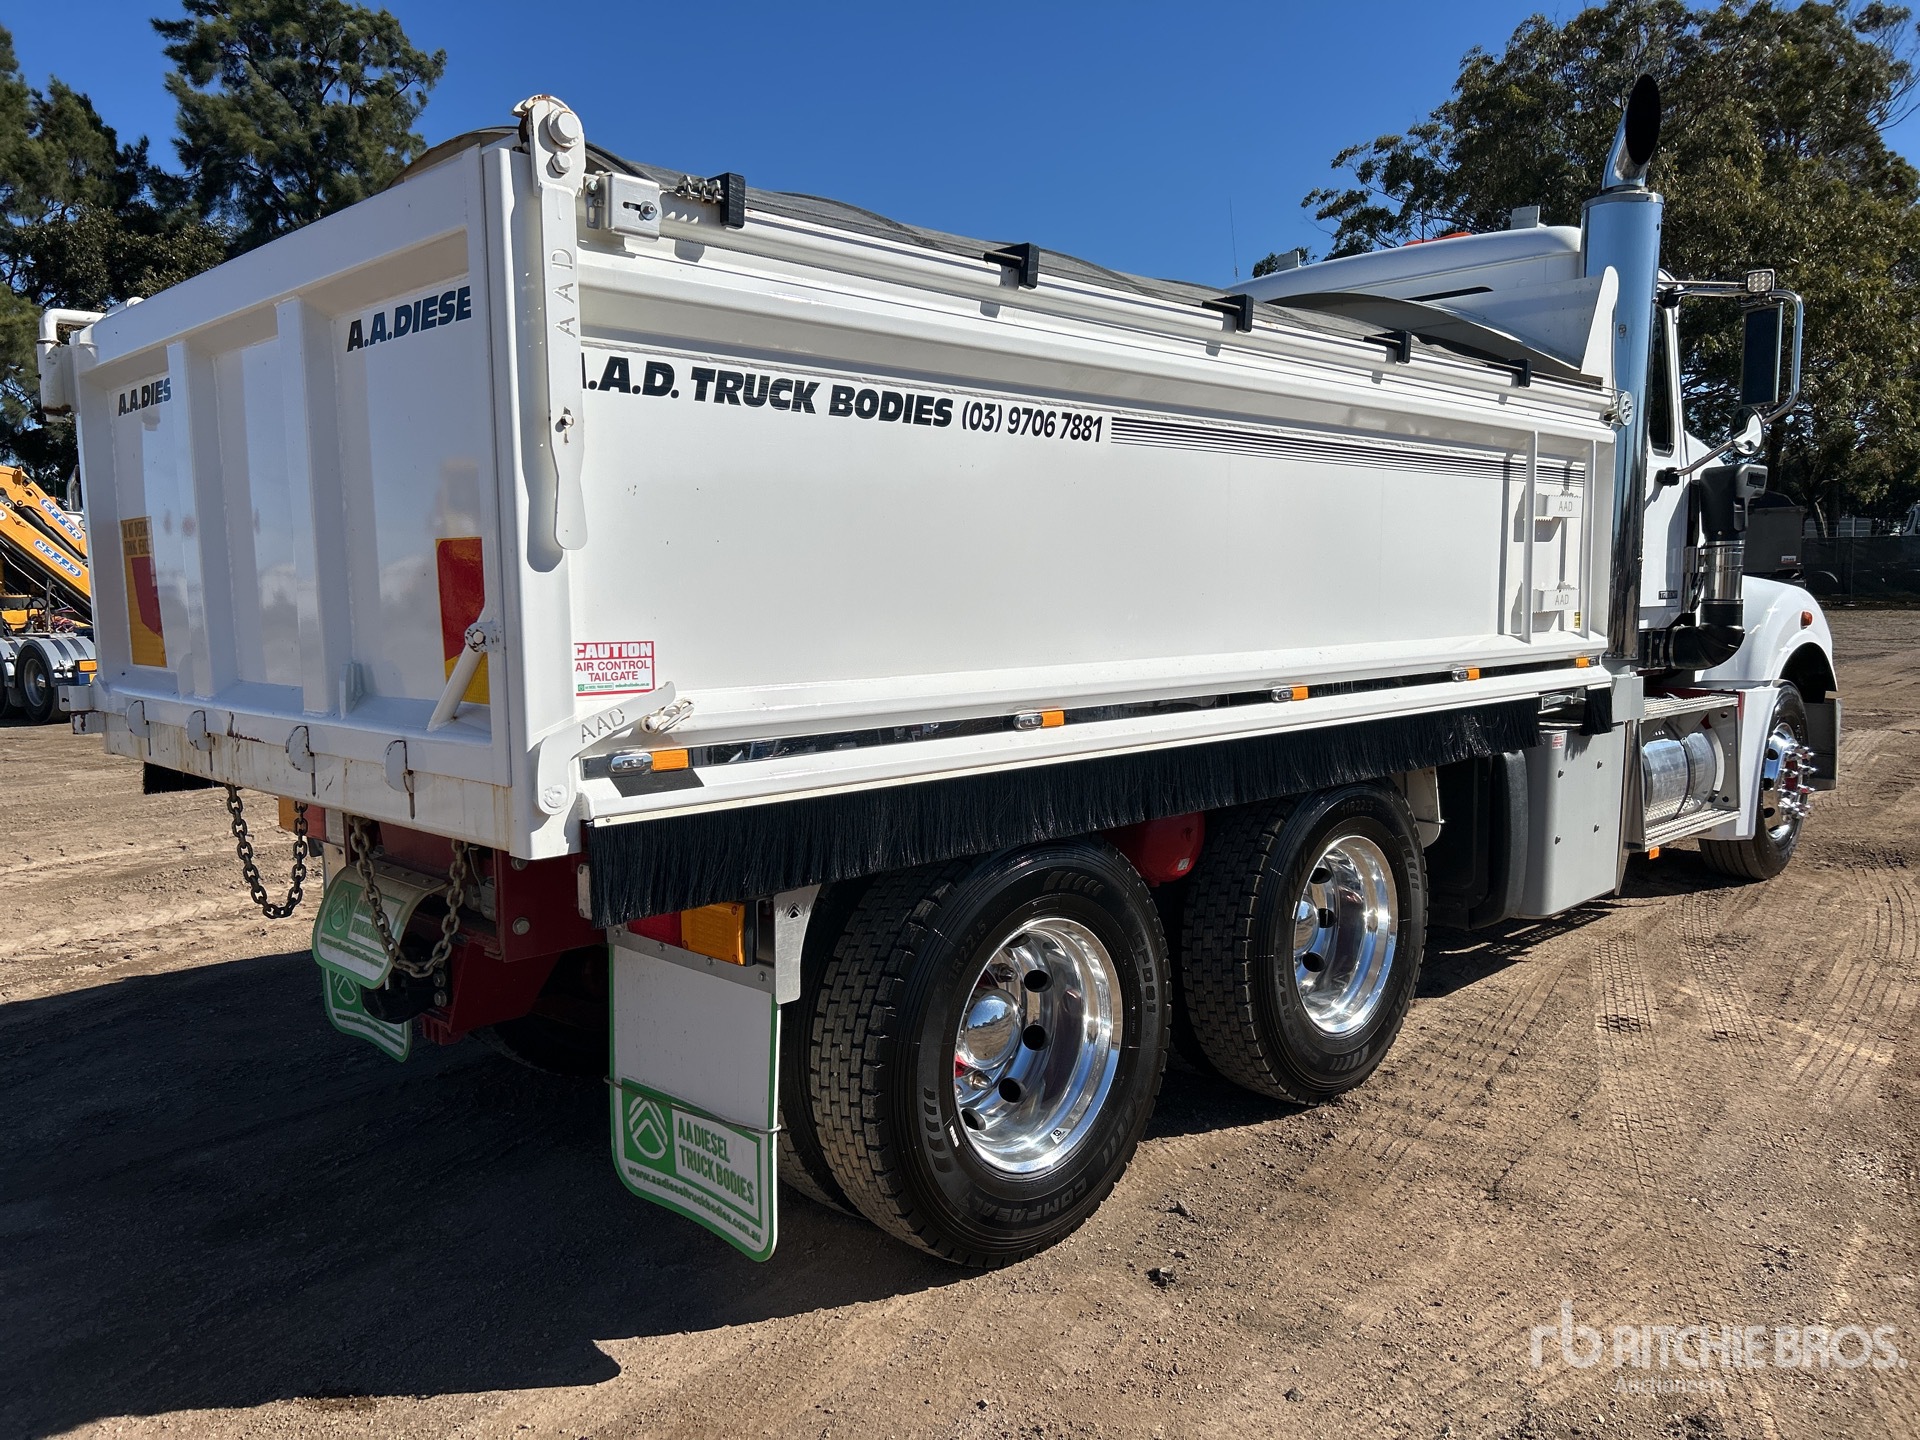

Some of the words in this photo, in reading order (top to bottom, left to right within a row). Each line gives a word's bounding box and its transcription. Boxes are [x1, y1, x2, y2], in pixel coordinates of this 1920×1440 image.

[581, 352, 680, 399] .A.D.
[691, 366, 821, 414] TRUCK
[828, 384, 954, 427] BODIES
[961, 400, 1002, 433] (03)
[1007, 406, 1057, 438] 9706
[1059, 412, 1103, 443] 7881
[1558, 500, 1573, 513] AAD
[43, 500, 81, 540] EFFER
[38, 541, 78, 576] EFFER
[1554, 593, 1570, 605] AAD
[574, 643, 652, 659] CAUTION
[575, 662, 594, 672] AIR
[597, 660, 651, 671] CONTROL
[588, 671, 639, 682] TAILGATE
[580, 708, 625, 743] AAD
[679, 1144, 716, 1182] TRUCK
[715, 1162, 755, 1206] BODIES
